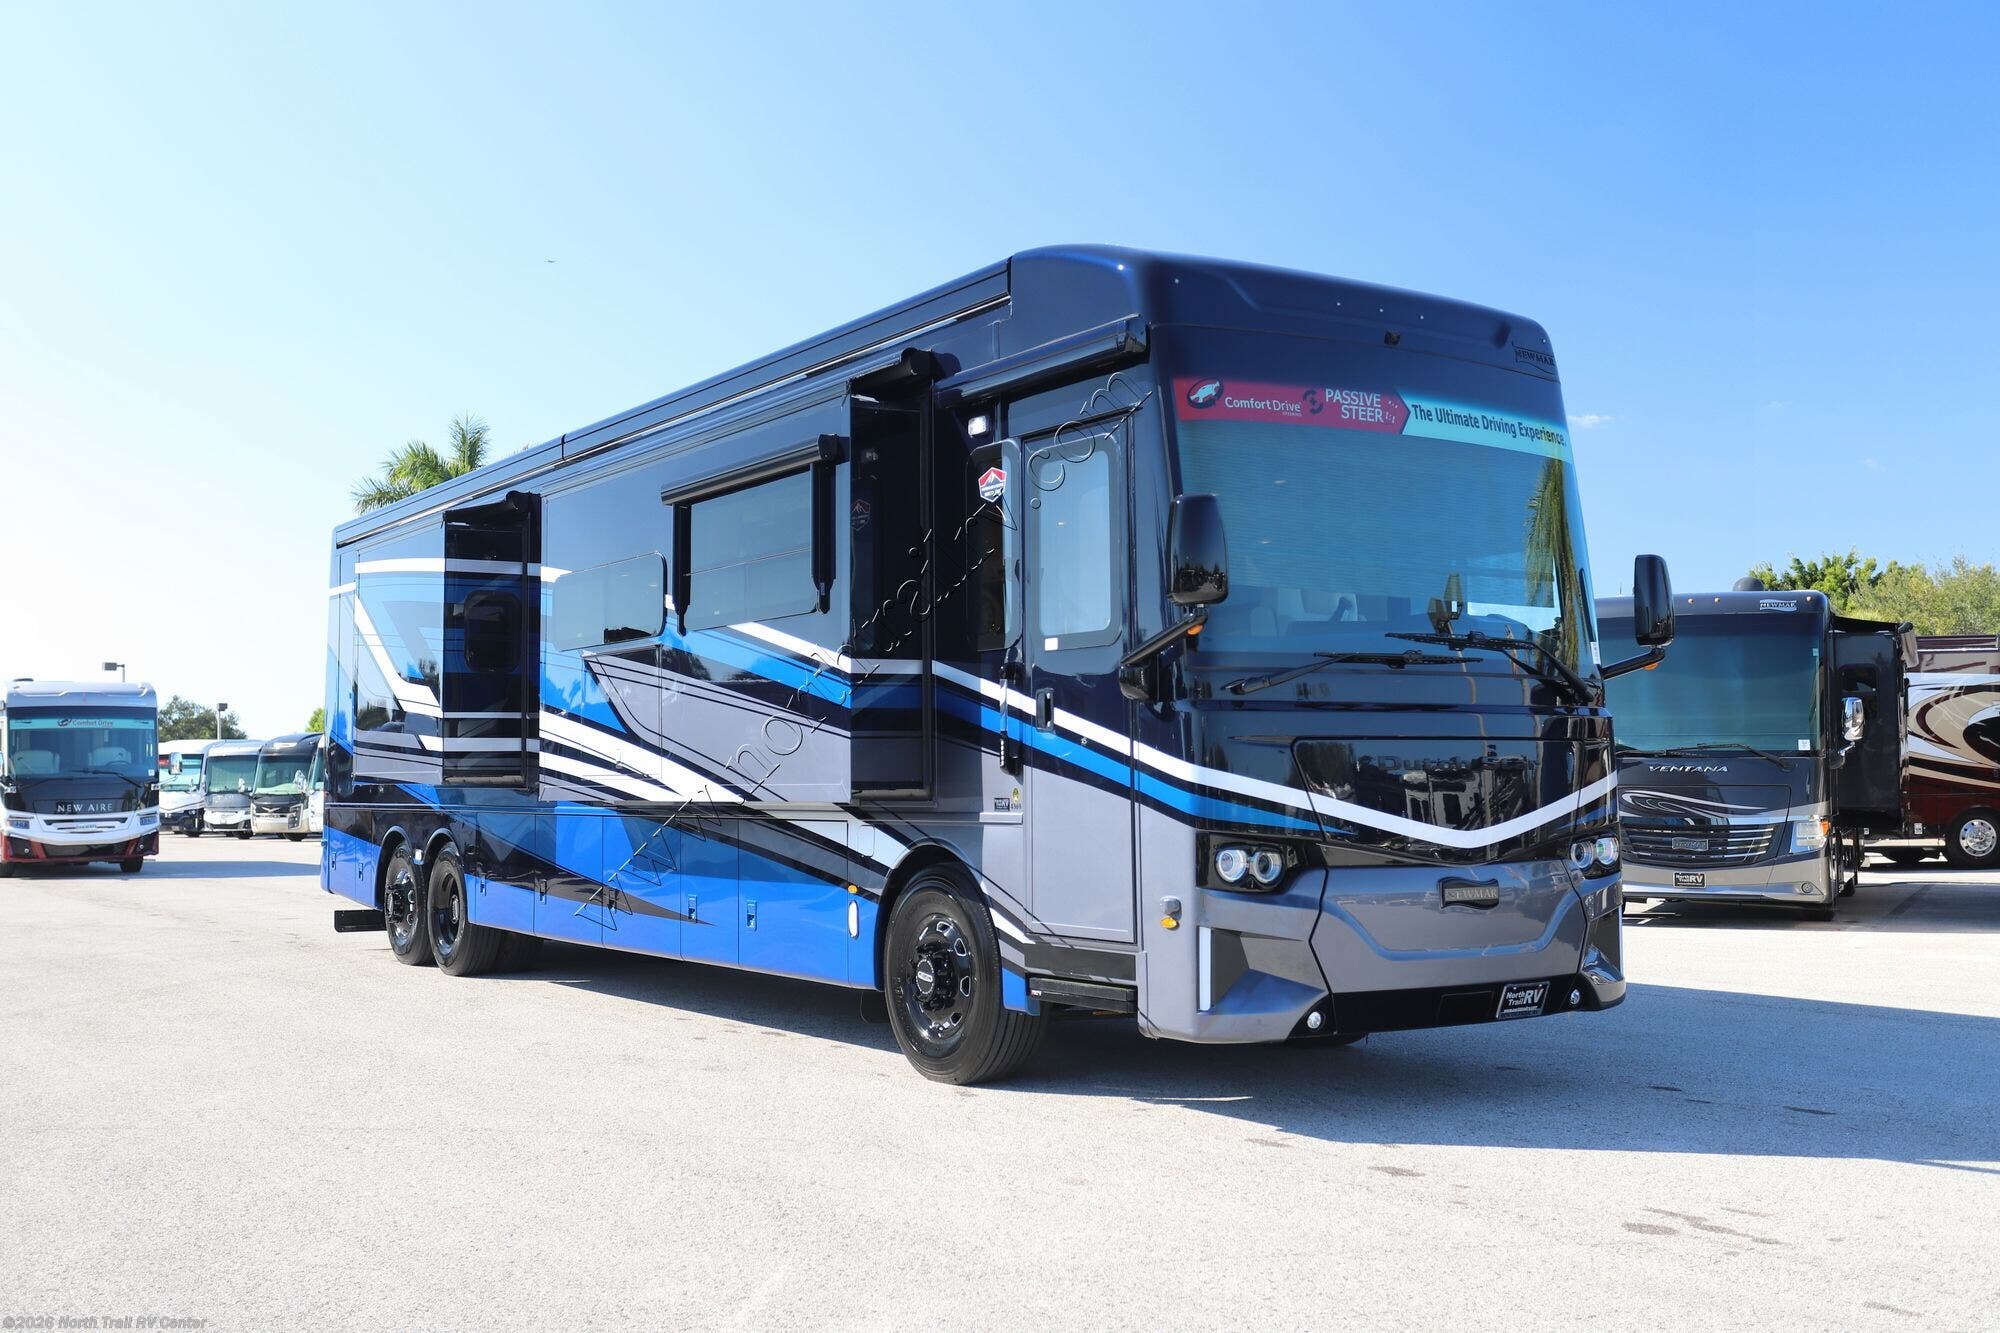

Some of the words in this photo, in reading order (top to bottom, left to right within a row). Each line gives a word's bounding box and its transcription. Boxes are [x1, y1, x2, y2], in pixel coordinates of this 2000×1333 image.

[1224, 396, 1271, 411] Comfort
[1272, 399, 1301, 412] Drive
[1325, 388, 1382, 407] PASSIVE
[1341, 404, 1384, 423] STEER
[1411, 404, 1433, 422] The
[1434, 407, 1480, 429] Ultimate
[1482, 415, 1517, 439] Driving
[1649, 765, 1728, 773] VENTANA
[57, 804, 83, 812] NEW
[88, 803, 113, 811] AIRE
[1506, 991, 1526, 999] North
[1524, 988, 1544, 1004] RV
